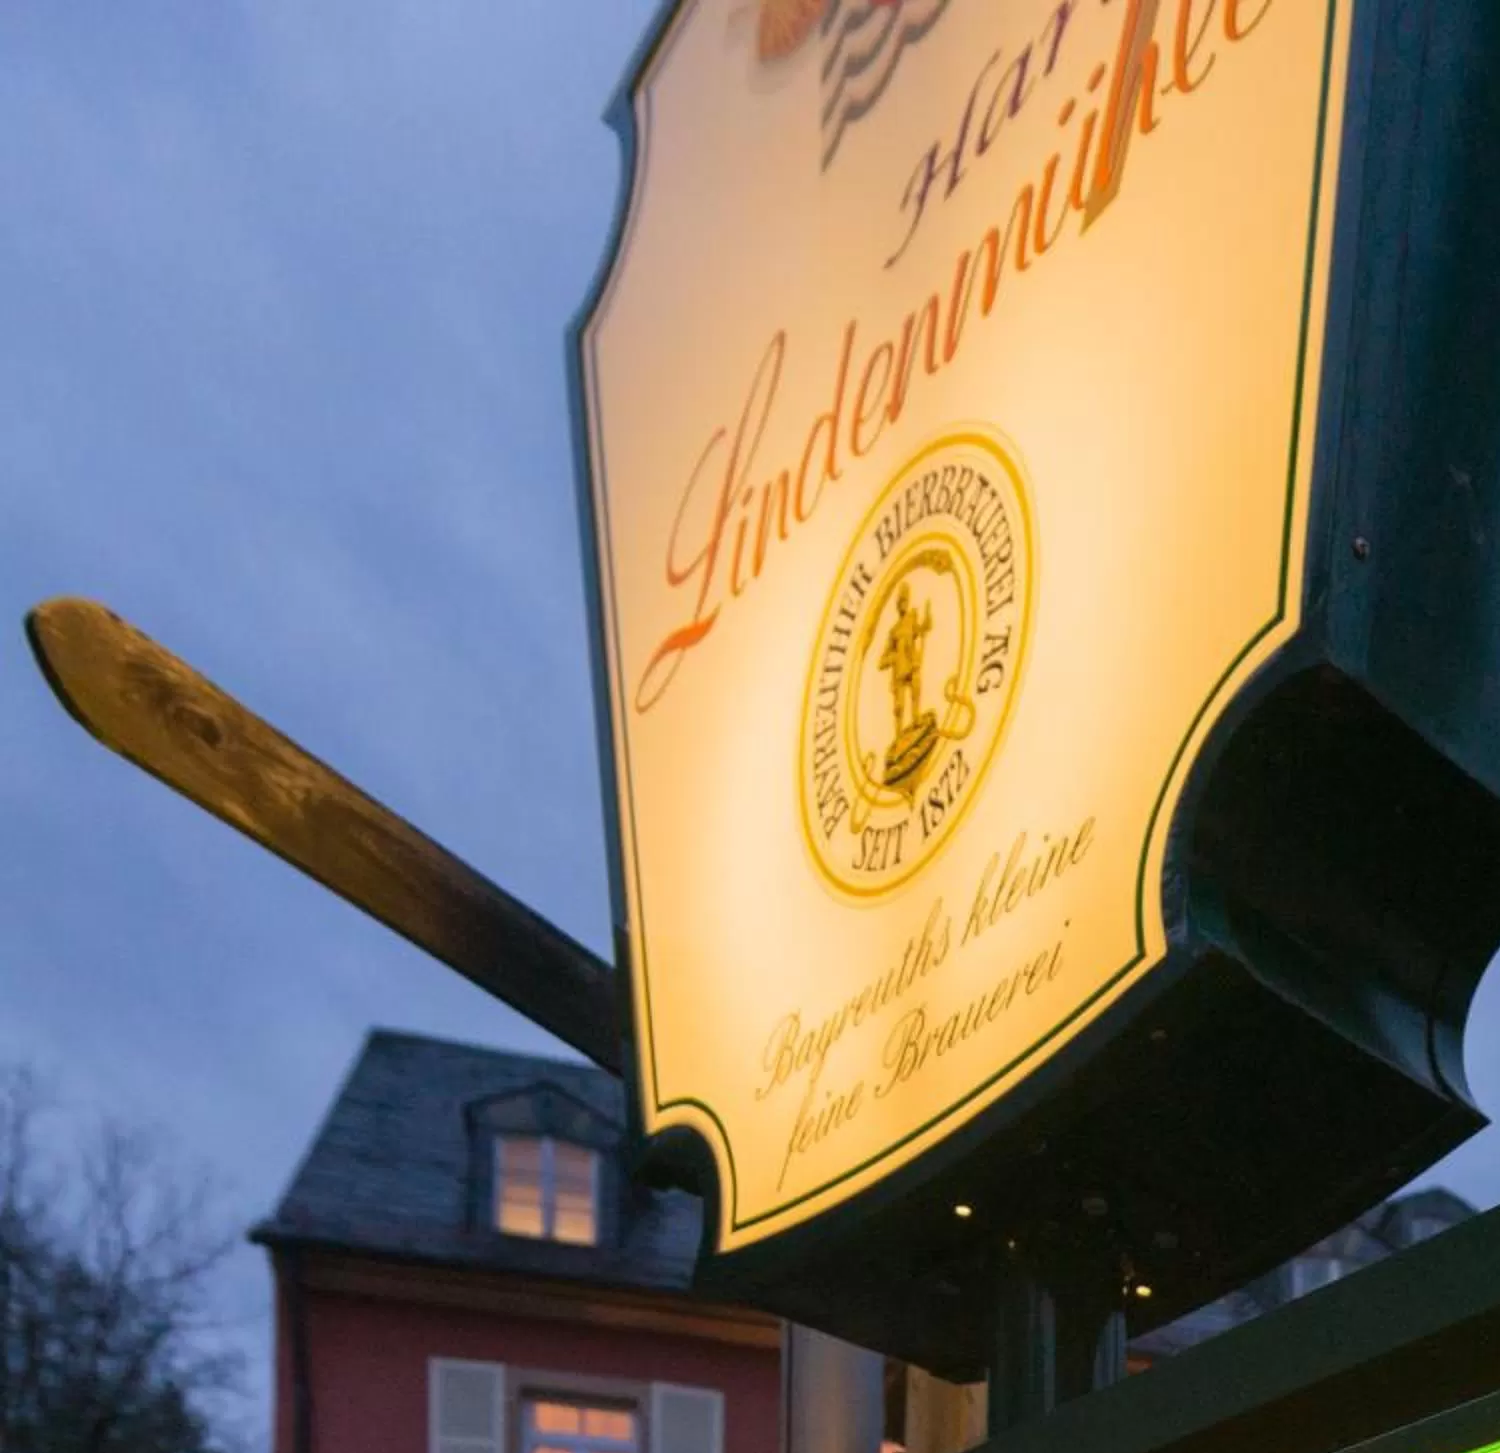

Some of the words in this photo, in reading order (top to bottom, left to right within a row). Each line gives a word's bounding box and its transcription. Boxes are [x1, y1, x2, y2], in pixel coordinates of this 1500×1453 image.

[976, 624, 1012, 696] AG
[850, 818, 910, 872] SEIT
[918, 748, 972, 845] 1872
[755, 896, 953, 1101] Bayreuths
[960, 816, 1097, 948] kleine
[775, 1072, 866, 1193] feine
[875, 919, 1074, 1099] Brauerei
